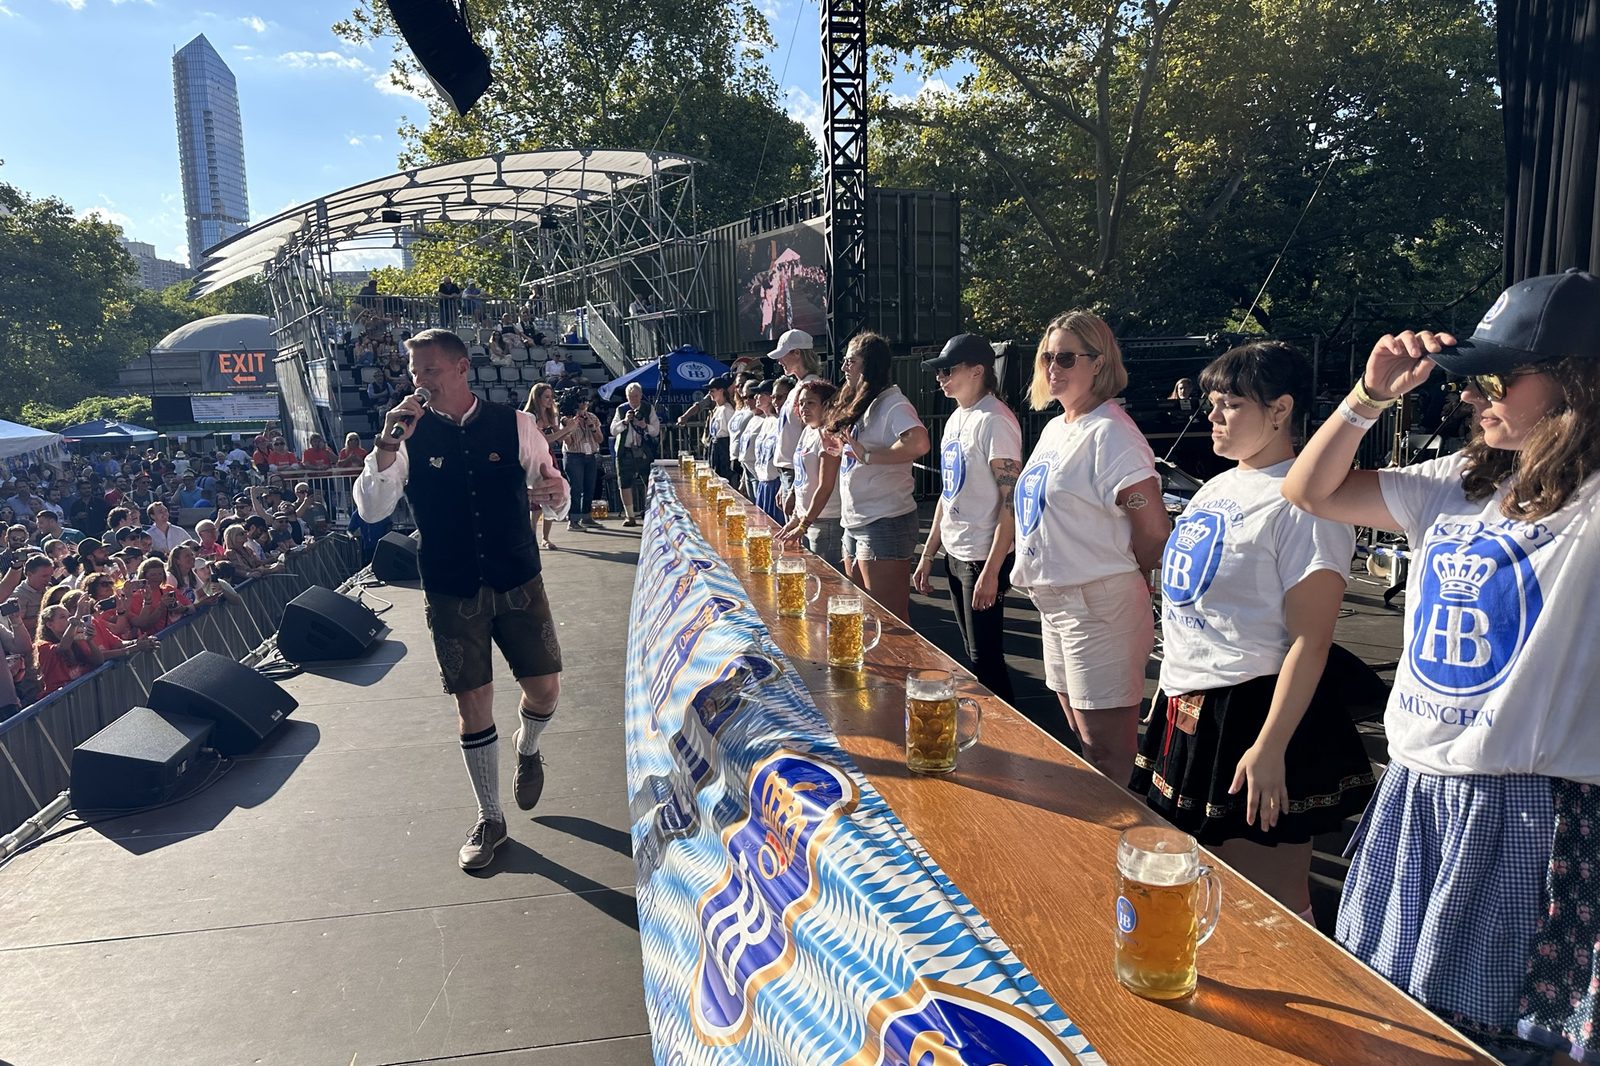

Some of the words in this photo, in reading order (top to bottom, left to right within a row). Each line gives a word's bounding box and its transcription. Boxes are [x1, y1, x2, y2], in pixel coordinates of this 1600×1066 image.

[218, 353, 266, 374] EXIT
[687, 370, 705, 379] HB
[1163, 547, 1193, 591] HB
[1419, 604, 1492, 668] HB
[1399, 692, 1496, 728] MÜNCHN
[1119, 911, 1131, 929] HB
